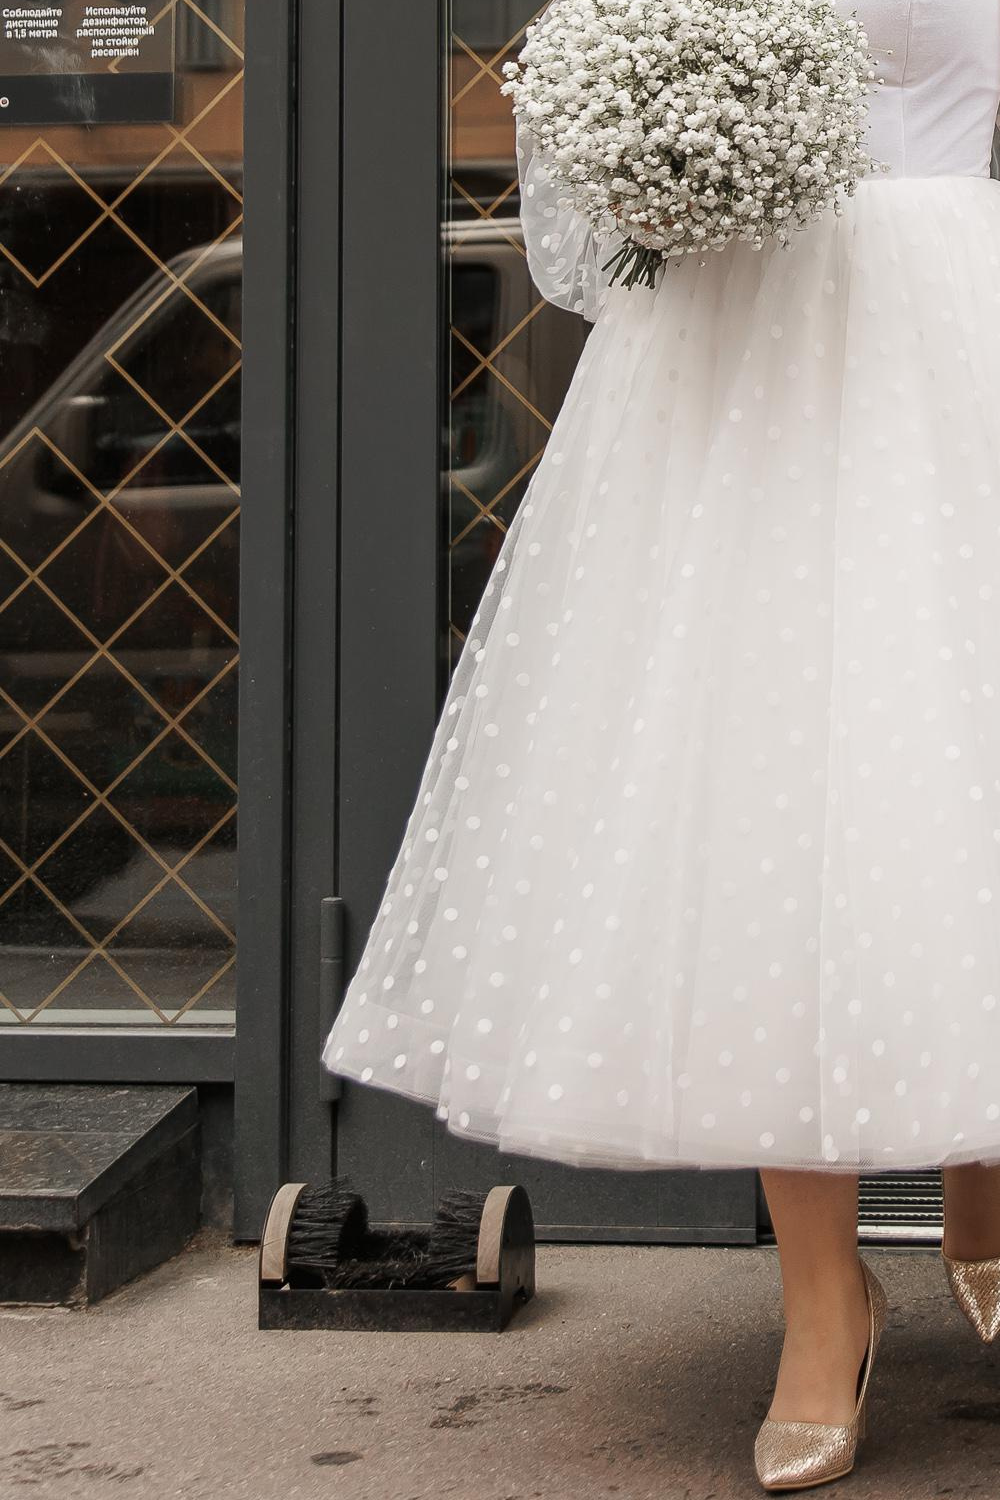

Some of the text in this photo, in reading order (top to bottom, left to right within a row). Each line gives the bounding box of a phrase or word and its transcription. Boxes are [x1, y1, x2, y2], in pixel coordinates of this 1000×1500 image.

[2, 7, 63, 19] Соблюдайте
[85, 5, 147, 16] Используйте
[5, 19, 59, 29] дистанцию
[82, 16, 149, 27] дезинфектор,
[14, 28, 27, 40] 1,5
[28, 29, 58, 39] метра
[76, 26, 155, 38] расположенный
[92, 36, 139, 47] на стойке
[91, 48, 139, 58] ресепшен
